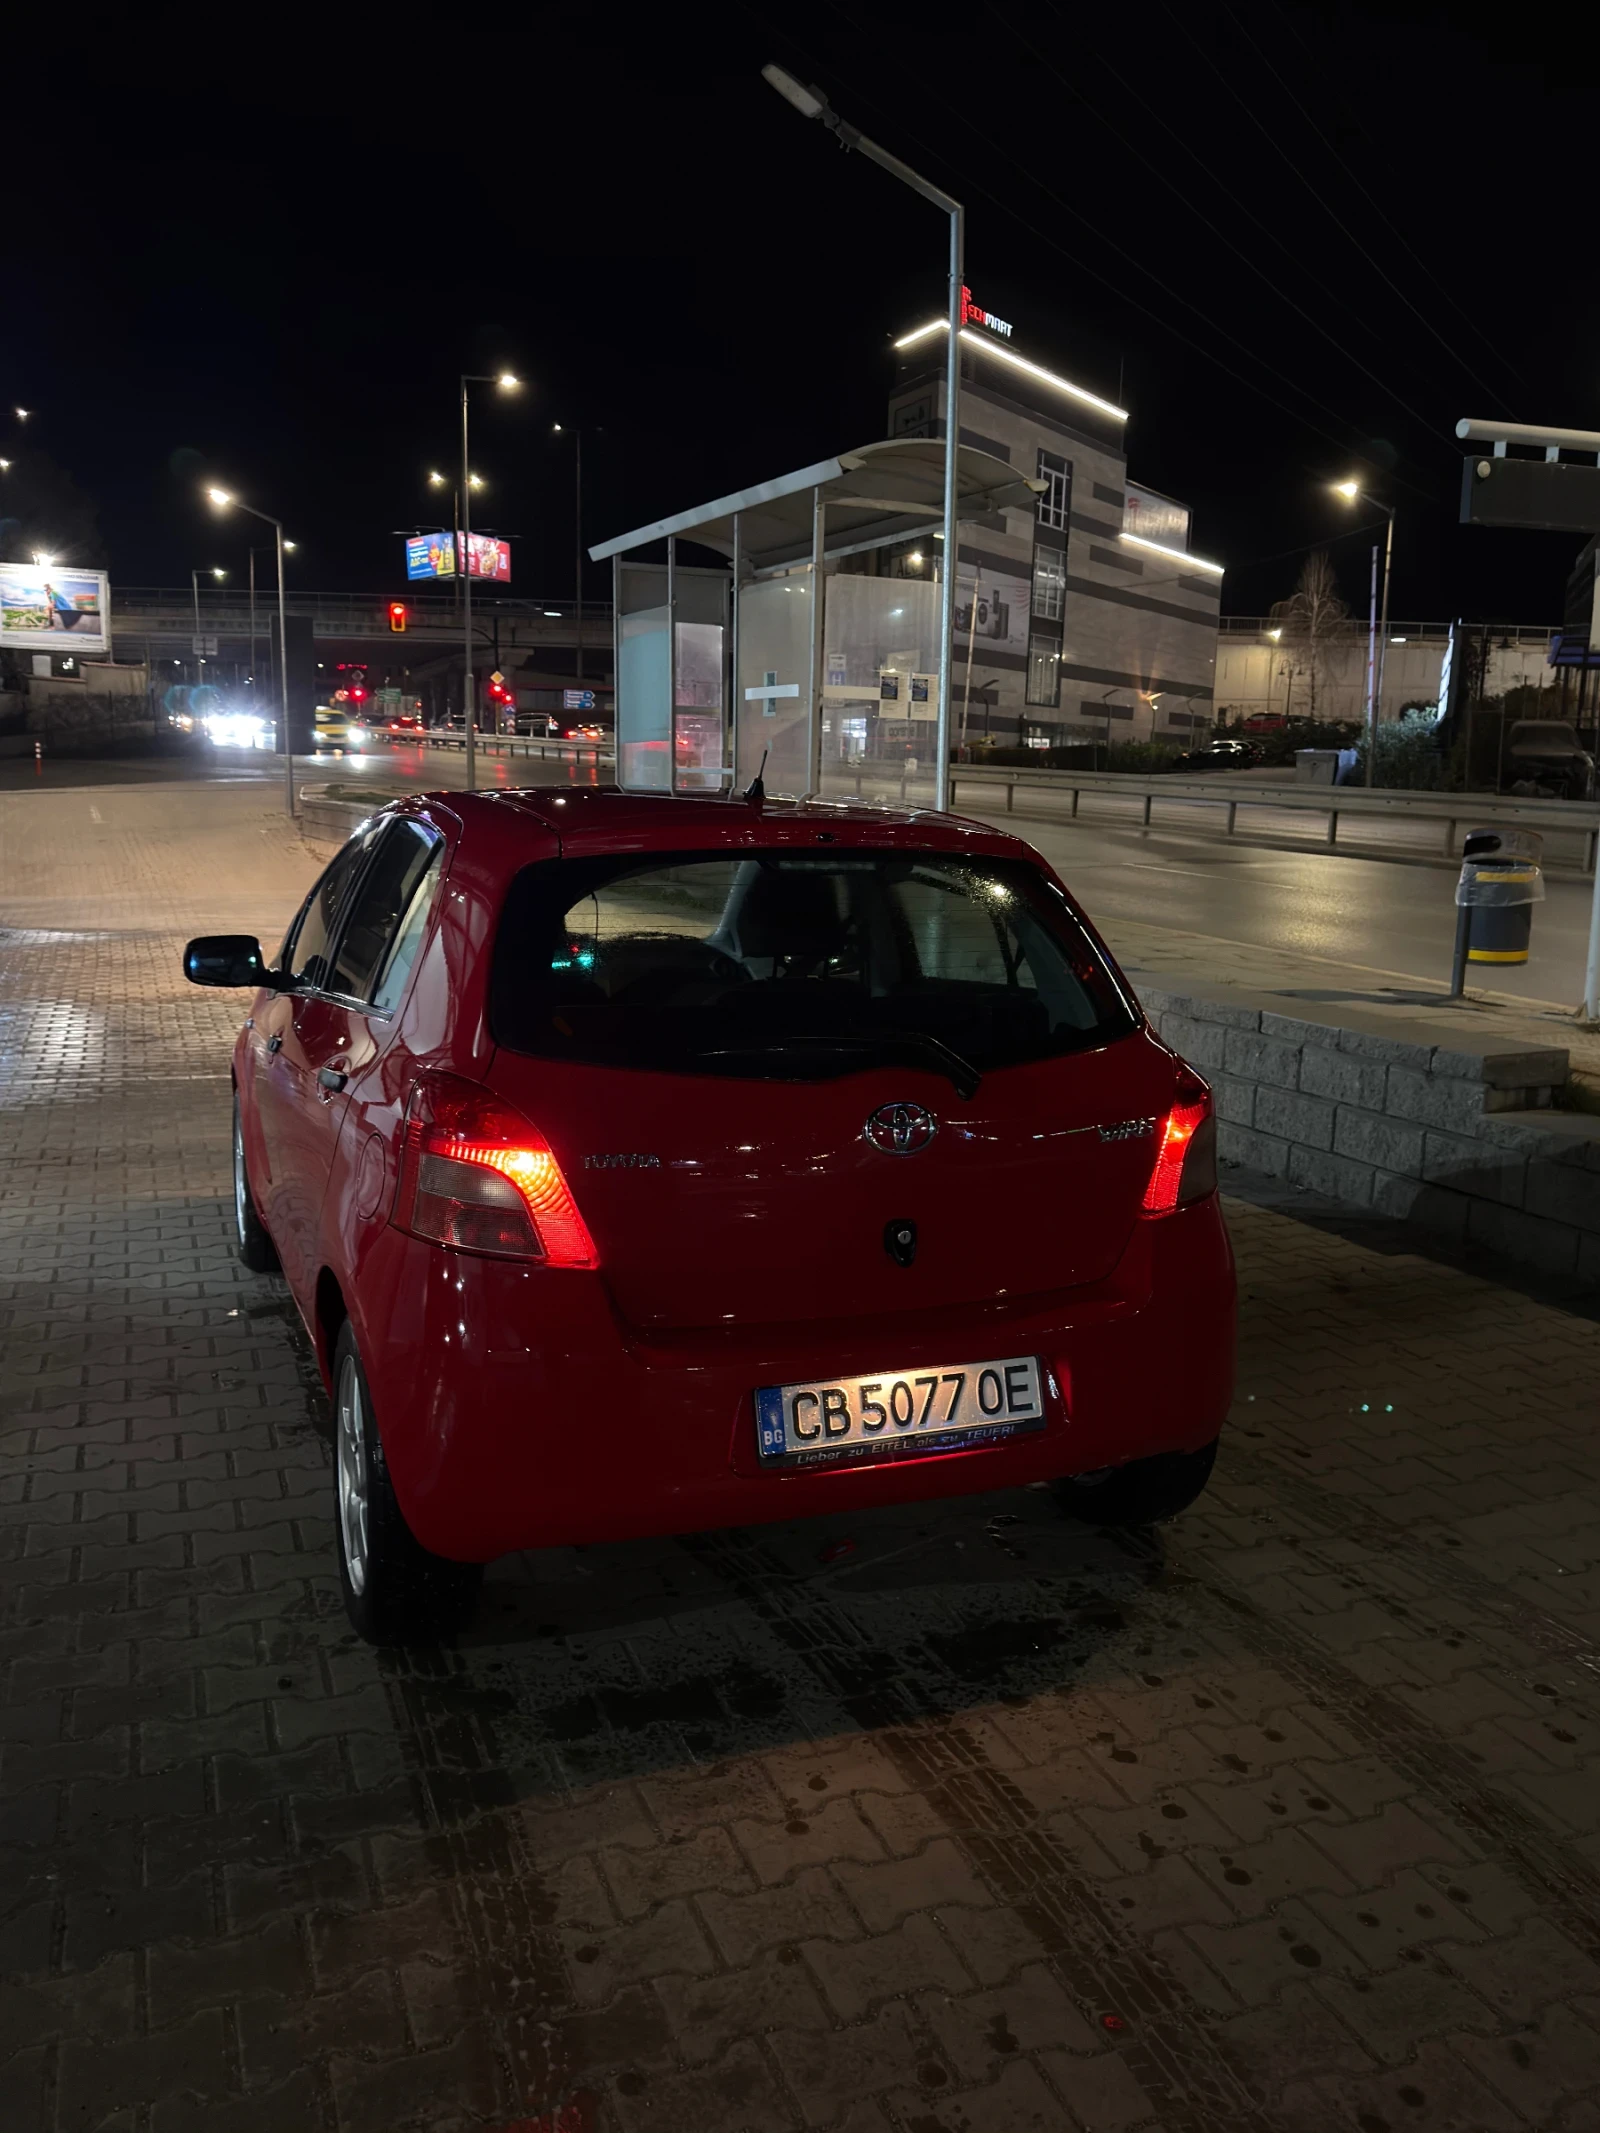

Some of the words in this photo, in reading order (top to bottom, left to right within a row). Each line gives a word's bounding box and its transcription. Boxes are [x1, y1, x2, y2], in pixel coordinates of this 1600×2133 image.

[581, 1154, 661, 1169] TOYOTA
[792, 1388, 850, 1440] CB
[860, 1373, 965, 1431] 5077
[763, 1429, 783, 1446] BG
[797, 1450, 842, 1464] Lieber
[848, 1447, 864, 1457] zu
[872, 1440, 910, 1453] EITEL
[917, 1437, 937, 1447] als
[941, 1435, 958, 1443] zu
[966, 1425, 1015, 1440] TEUER!
